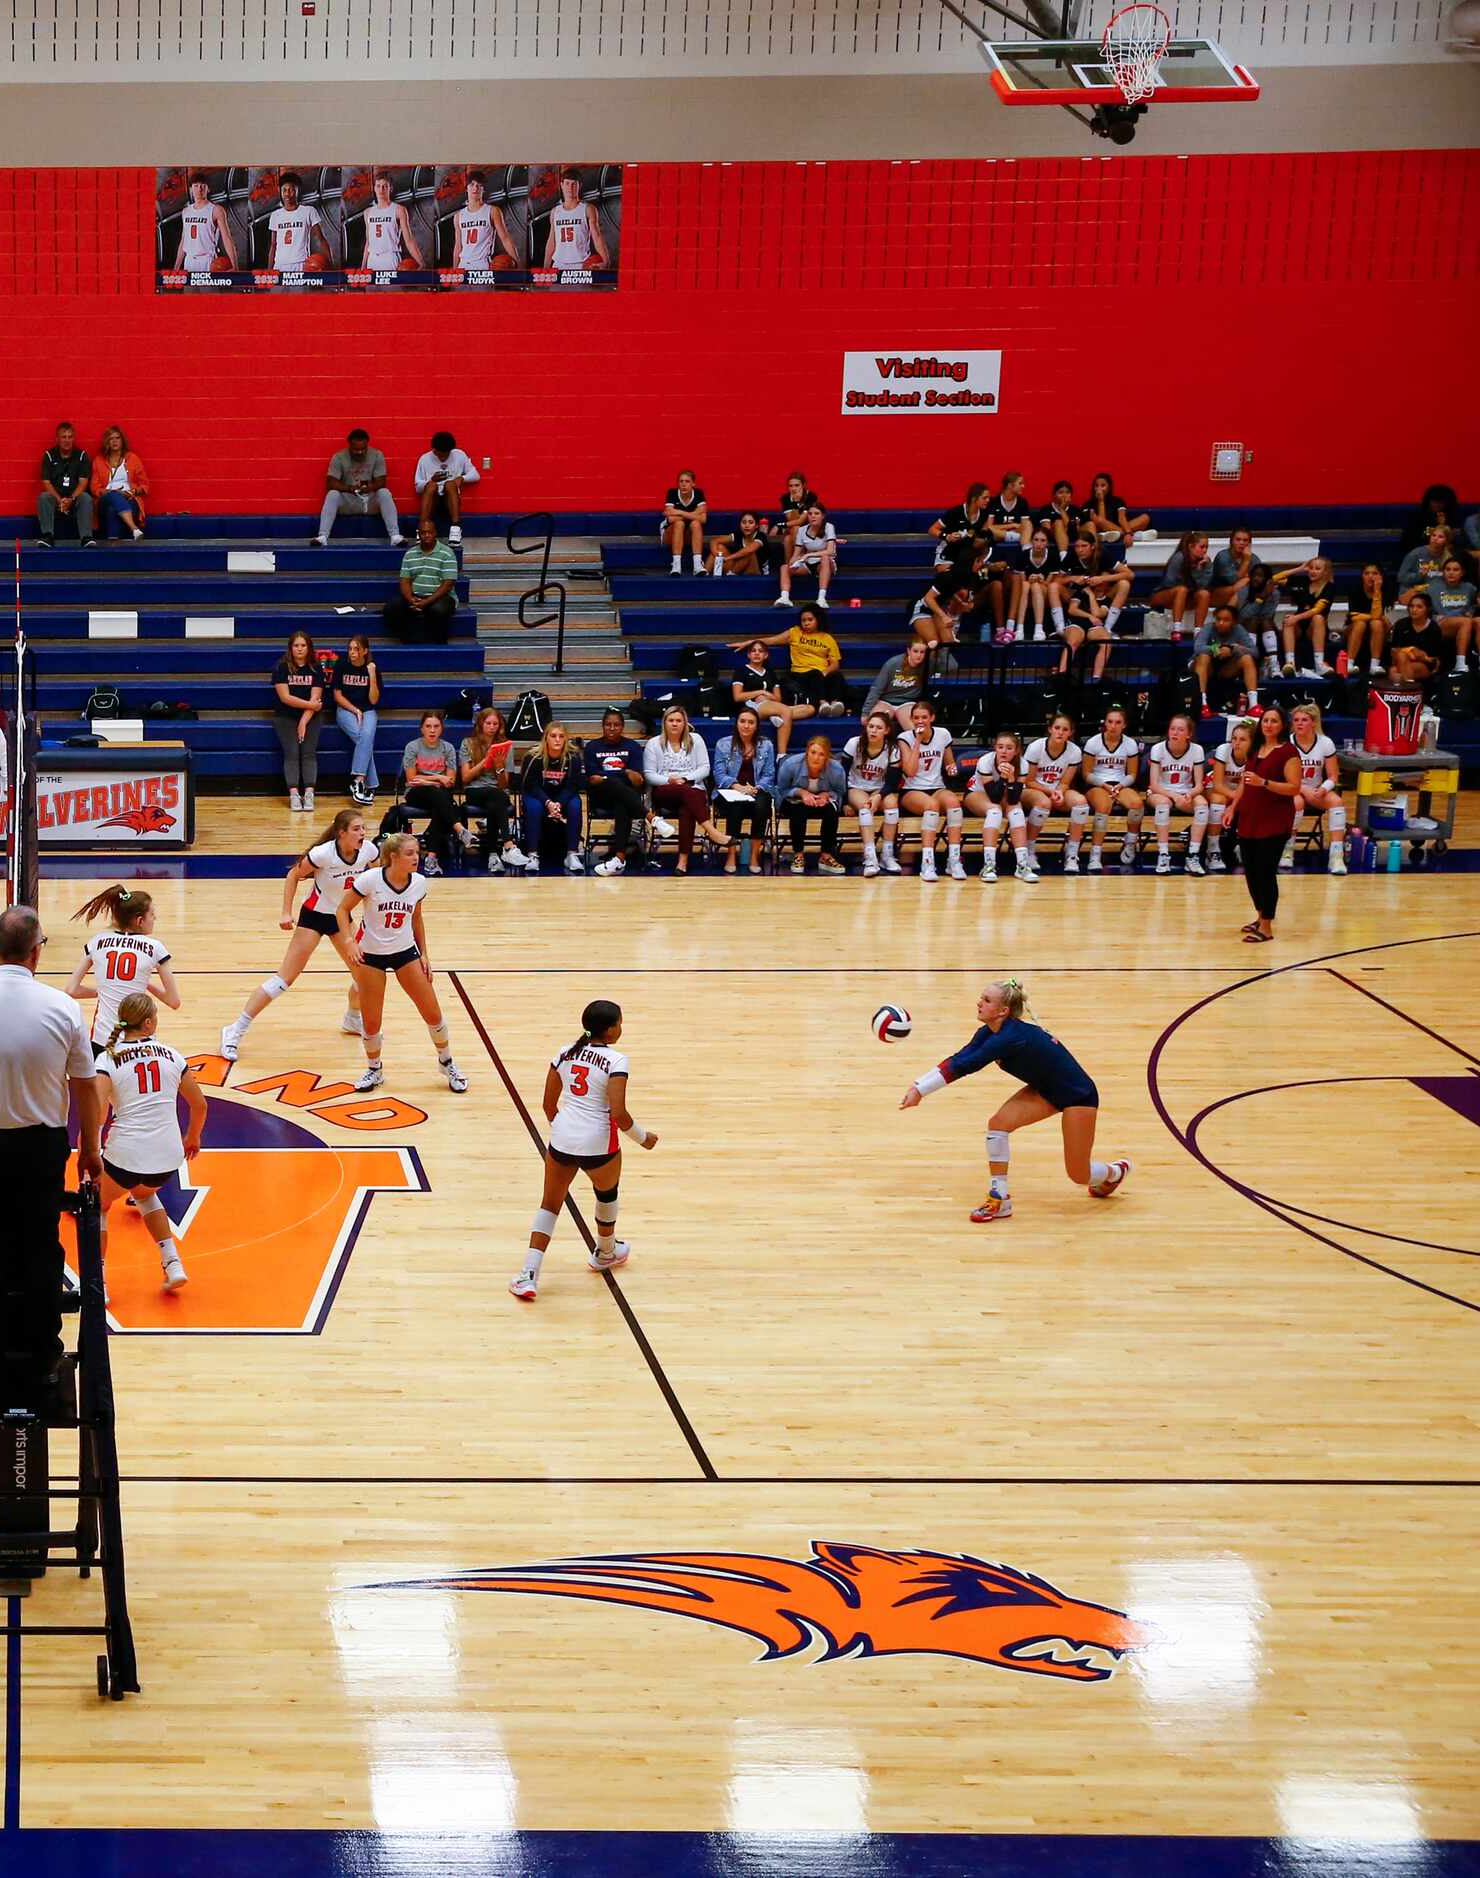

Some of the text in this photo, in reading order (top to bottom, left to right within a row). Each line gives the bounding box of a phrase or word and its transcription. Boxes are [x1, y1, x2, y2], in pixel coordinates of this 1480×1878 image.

[162, 275, 187, 286] 2023
[191, 279, 232, 287] DEMAURO
[254, 275, 279, 286] 2023
[282, 279, 323, 287] HAMPTON
[347, 274, 372, 283] 2023
[375, 278, 390, 286] LEE
[875, 357, 969, 382] Visiting
[846, 389, 995, 407] Student Section
[46, 776, 62, 784] THE
[377, 901, 414, 913] WAKELAND
[384, 912, 406, 929] 13
[97, 937, 155, 958] WOLVERINES
[105, 950, 138, 981] 10
[134, 1060, 161, 1094] 11
[570, 1064, 590, 1097] 3
